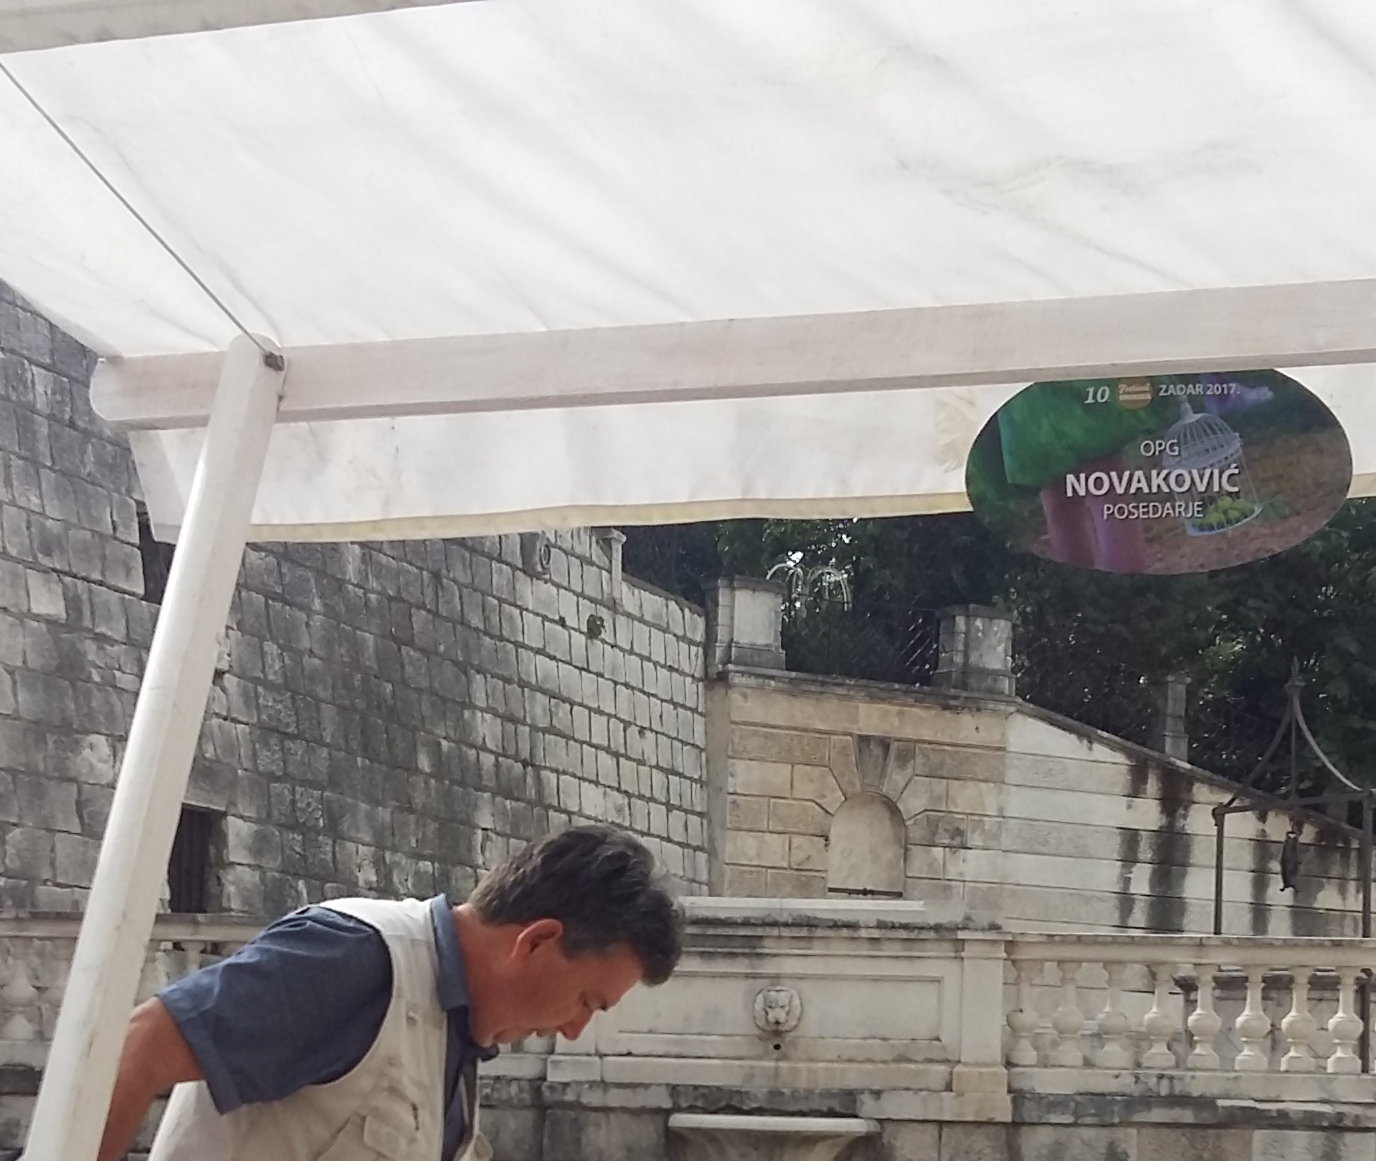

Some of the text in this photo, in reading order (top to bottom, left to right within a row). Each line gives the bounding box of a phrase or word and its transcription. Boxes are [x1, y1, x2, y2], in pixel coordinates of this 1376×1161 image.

[1083, 385, 1110, 404] 10
[1158, 383, 1204, 397] ZADAR
[1205, 383, 1241, 396] 2017.
[1139, 440, 1180, 457] OPG
[1064, 463, 1241, 498] NOVAKOVIĆ
[1103, 502, 1204, 520] POSEDARJE
